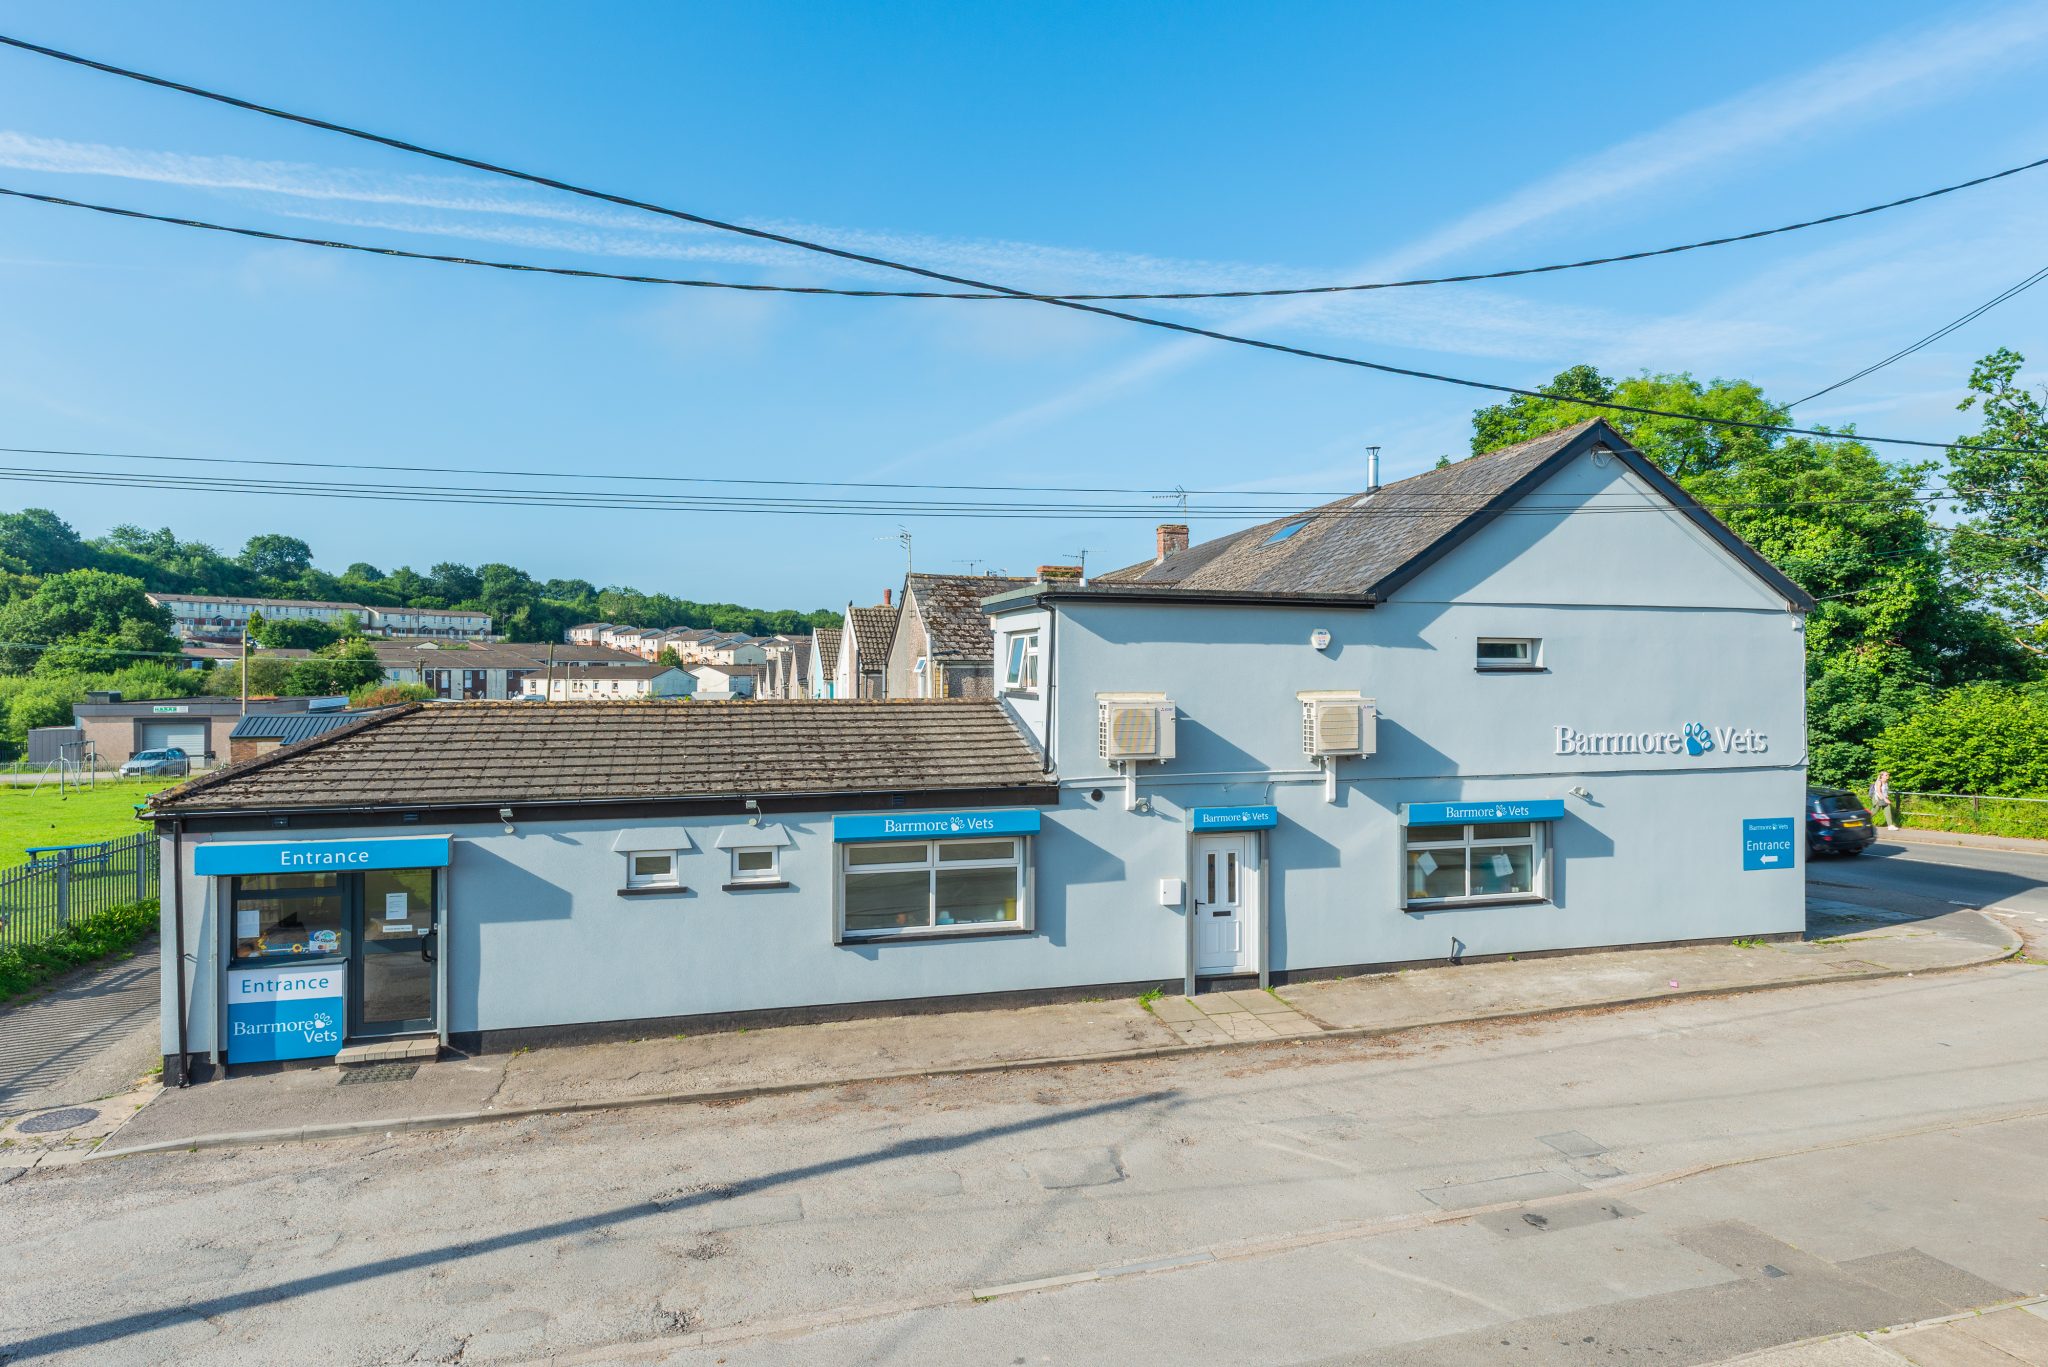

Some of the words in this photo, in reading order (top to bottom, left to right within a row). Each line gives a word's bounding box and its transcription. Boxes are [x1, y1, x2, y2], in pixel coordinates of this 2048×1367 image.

[1553, 725, 1682, 755] Barrmore
[1715, 726, 1768, 753] Vets
[1202, 814, 1241, 823] Barrmore
[1252, 812, 1269, 821] Vets
[1445, 806, 1495, 818] Barrmore
[1508, 805, 1529, 816] Vets
[884, 819, 949, 833] Barrmore
[967, 817, 994, 830] Vets
[1746, 840, 1791, 851] Entrance
[281, 850, 369, 866] Entrance
[242, 977, 329, 994] Entrance
[234, 1020, 314, 1036] Barrmore
[303, 1029, 338, 1043] Vets
